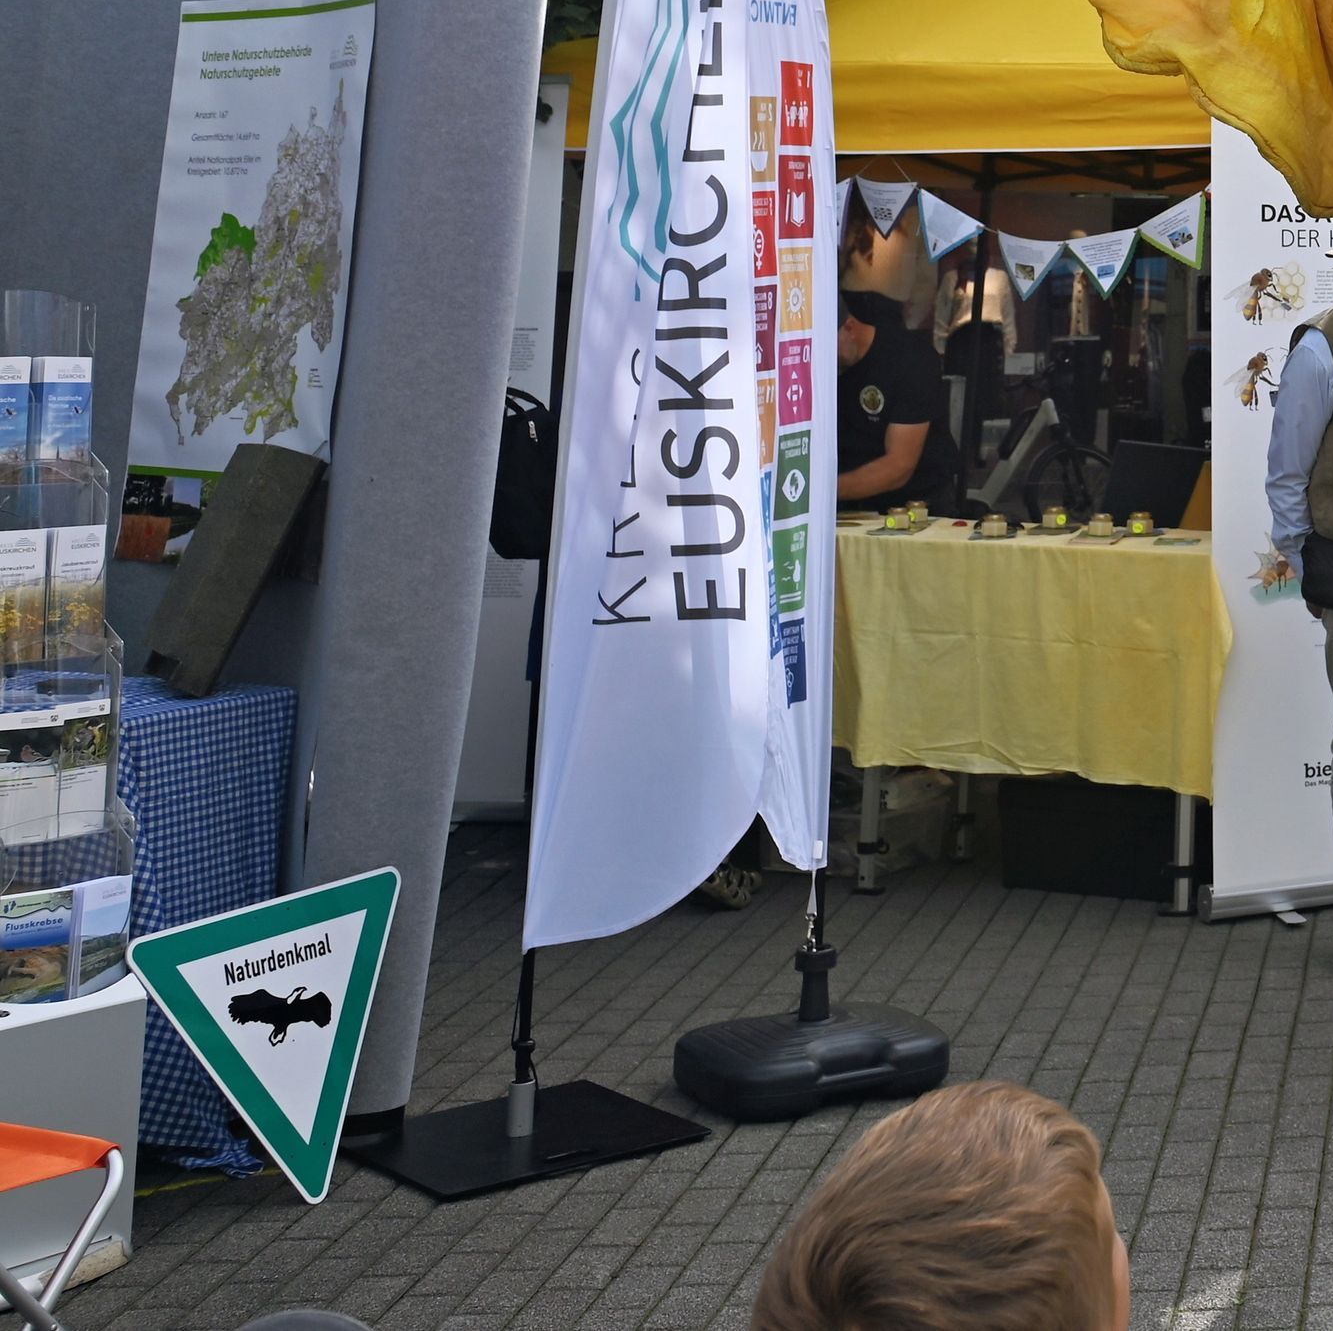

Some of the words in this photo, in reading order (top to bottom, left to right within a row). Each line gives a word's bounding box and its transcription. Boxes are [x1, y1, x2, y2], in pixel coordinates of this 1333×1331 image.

[201, 50, 230, 63] Untere
[231, 44, 313, 61] Naturschutzbehörde
[199, 66, 281, 81] Naturschutzgebiete
[1261, 204, 1307, 223] DAS
[1281, 229, 1320, 248] DER
[5, 917, 64, 932] Flusskrebse
[224, 932, 332, 986] Naturdenkmal
